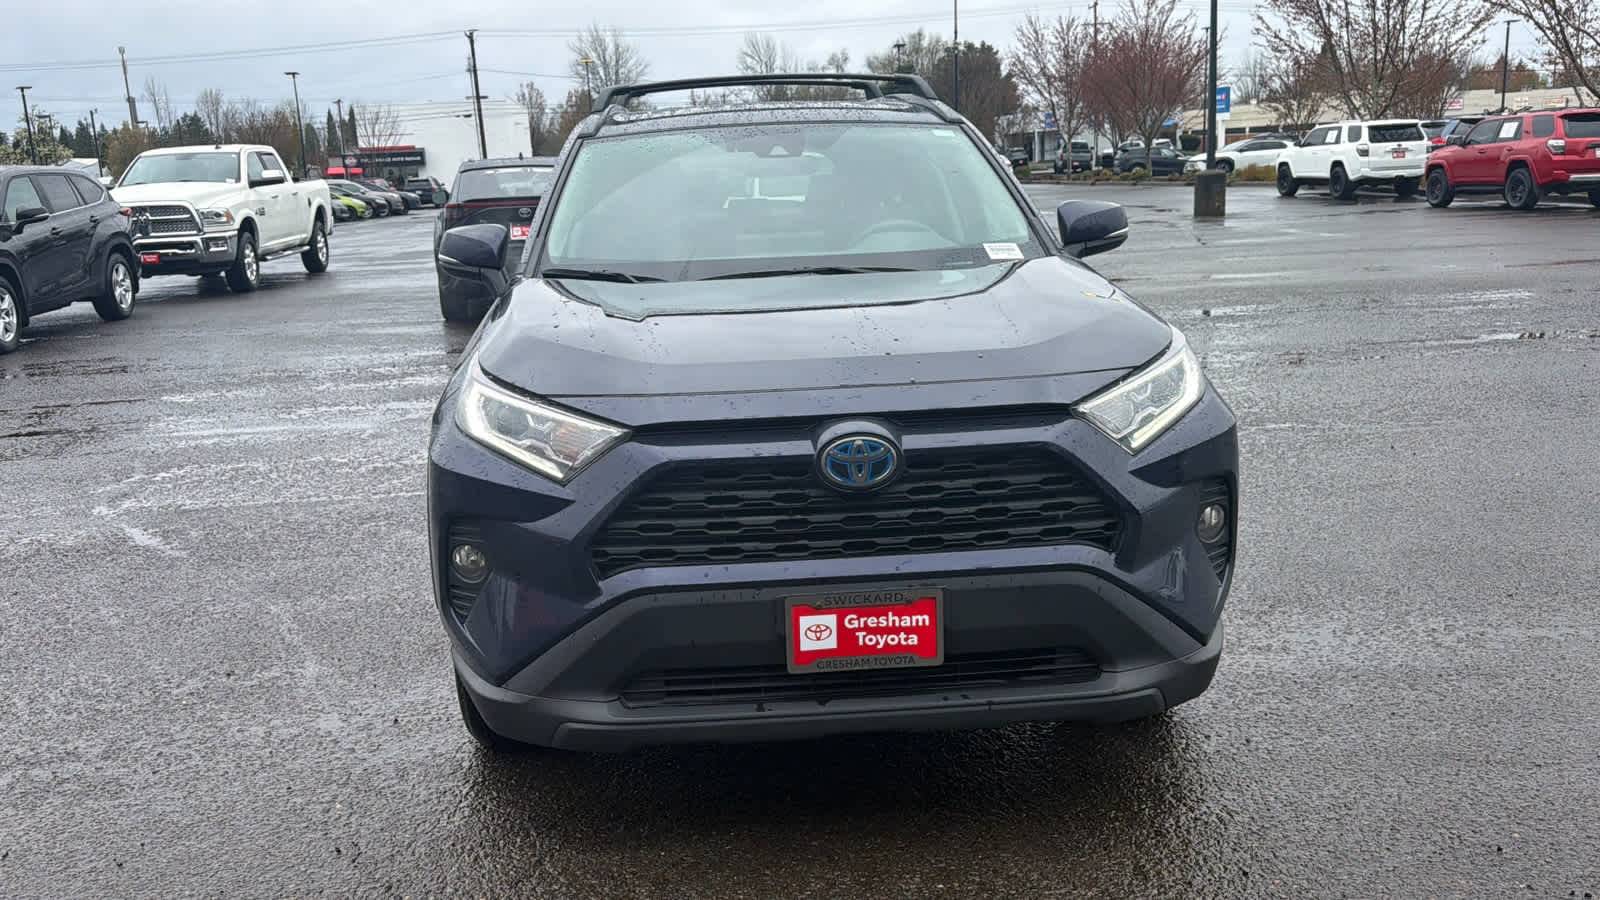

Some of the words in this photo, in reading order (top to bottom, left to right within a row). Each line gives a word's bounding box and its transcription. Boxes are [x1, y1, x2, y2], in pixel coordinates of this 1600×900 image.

[823, 592, 905, 607] SWICKARD
[844, 611, 930, 629] Gresham
[855, 631, 919, 649] Toyota
[816, 657, 870, 670] GRESHAM
[872, 655, 916, 667] TOYOTA
